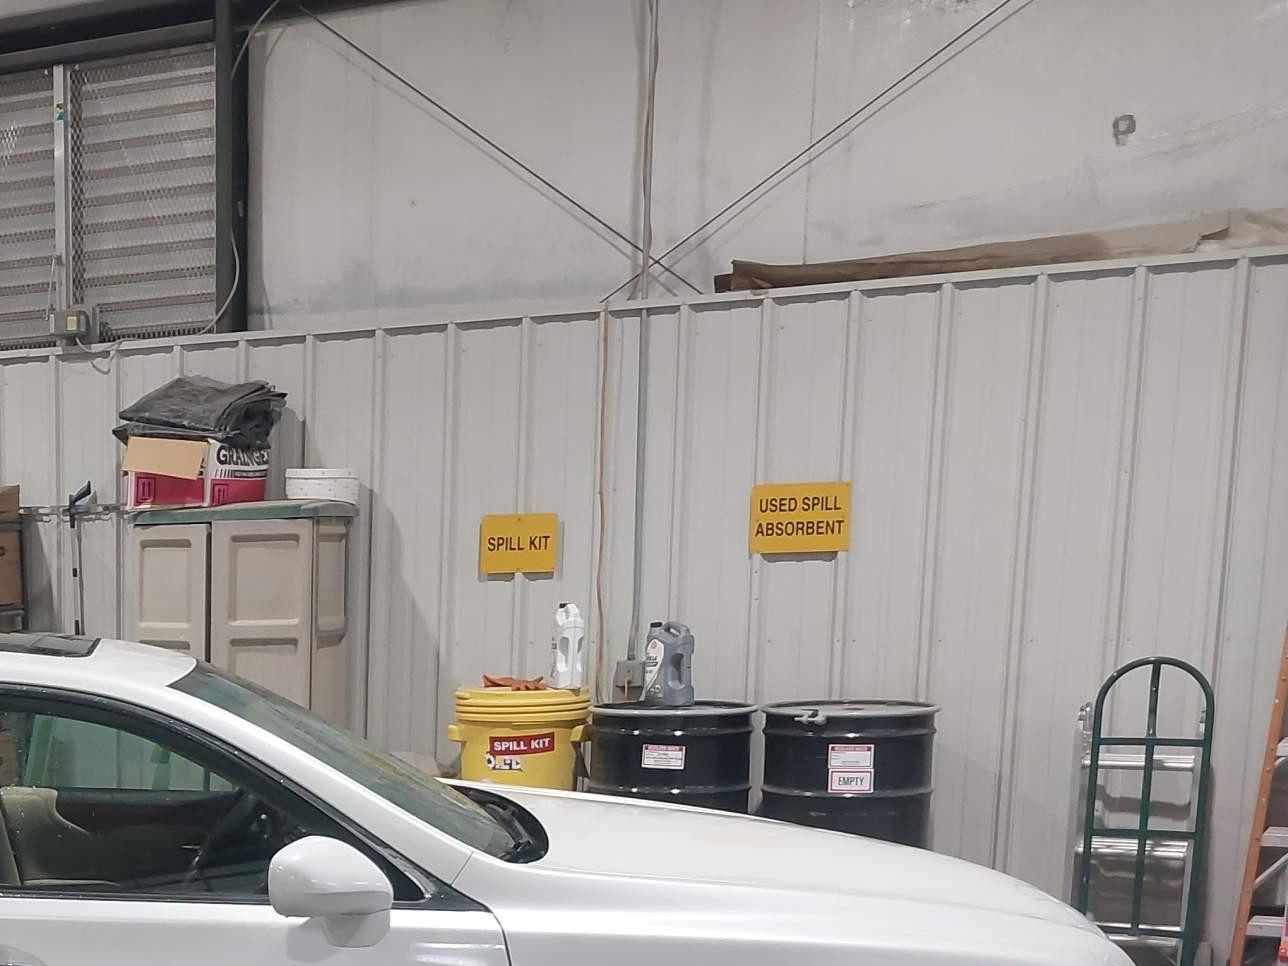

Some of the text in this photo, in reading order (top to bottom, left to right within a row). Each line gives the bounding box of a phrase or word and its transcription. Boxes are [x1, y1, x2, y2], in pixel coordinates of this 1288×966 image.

[759, 496, 842, 513] USED SPILL
[755, 519, 845, 537] ABSORBENT
[487, 535, 551, 552] SPILL KIT
[493, 737, 552, 751] SPILL KIT
[838, 776, 865, 786] EMPTY
